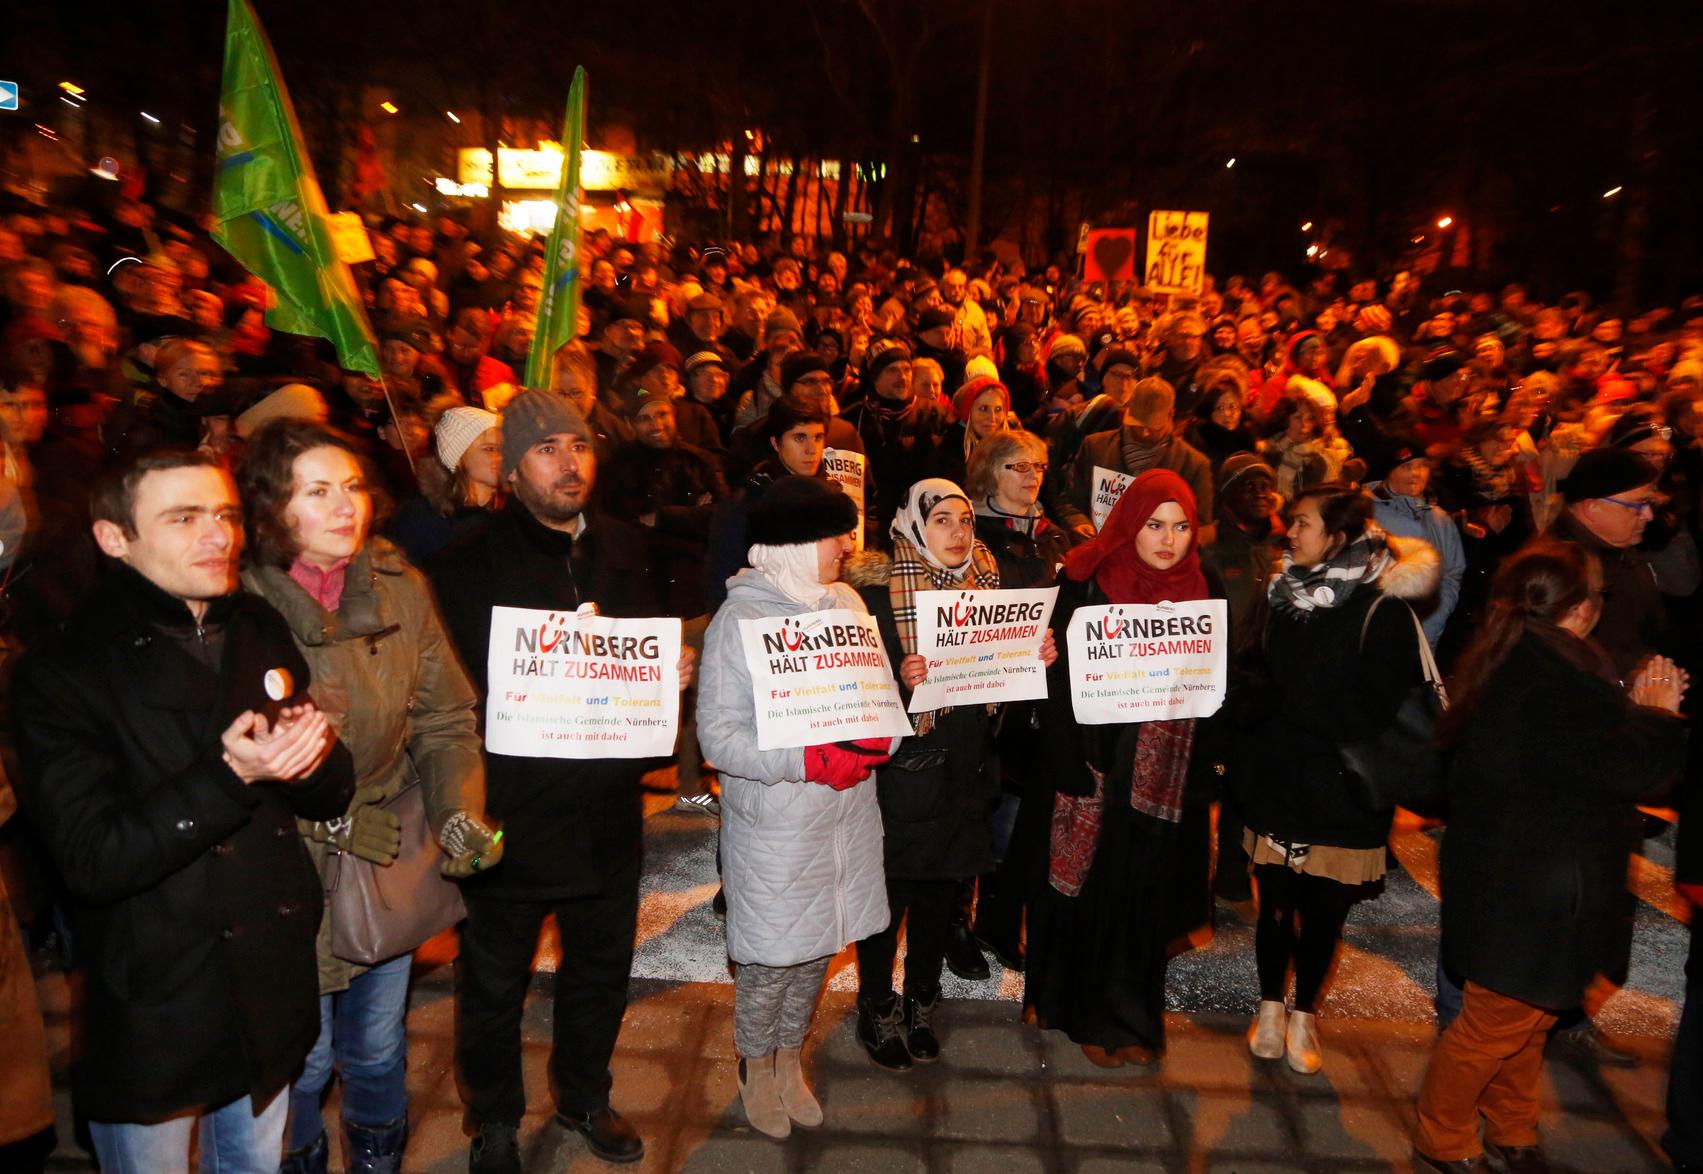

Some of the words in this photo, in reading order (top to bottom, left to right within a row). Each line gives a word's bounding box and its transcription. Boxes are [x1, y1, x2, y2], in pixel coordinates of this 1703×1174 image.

[824, 458, 862, 476] NBERG
[937, 592, 1044, 627] NÜRNBERG
[1086, 606, 1212, 641] NÜRNBERG
[515, 613, 659, 659] NÜRNBERG
[763, 618, 878, 654] NÜRNBERG
[936, 629, 967, 647] HÄLT
[970, 625, 1038, 644] ZUSAMMEN
[929, 660, 943, 668] Für
[945, 656, 976, 666] Vielfalt
[978, 653, 994, 662] und
[997, 649, 1032, 661] Toleranz
[1088, 642, 1123, 660] HÄLT
[1129, 640, 1211, 657] ZUSAMMEN
[513, 656, 559, 676] HÄLT
[565, 661, 661, 681] ZUSAMMEN
[770, 655, 808, 674] HÄLT
[814, 652, 884, 670] ZUSAMMEN
[934, 673, 966, 684] Islamische
[969, 669, 1000, 678] Gemeinde
[1003, 665, 1037, 674] Nürnberg
[1086, 673, 1103, 681] Für
[1106, 671, 1146, 680] Vielfalt
[1149, 668, 1169, 677] und
[1173, 667, 1211, 676] Toleranz
[771, 689, 791, 699] Für
[794, 685, 836, 697] Vielfalt
[839, 682, 857, 691] und
[861, 681, 891, 690] Toleranz
[946, 685, 954, 693] ist
[955, 683, 972, 692] auch
[974, 681, 985, 690] mit
[987, 680, 1005, 688] dabei
[1081, 691, 1093, 699] Die
[1097, 688, 1140, 697] Islamische
[1142, 686, 1181, 694] Gemeinde
[1182, 684, 1216, 692] Nürnberg
[505, 692, 527, 701] Für
[587, 696, 608, 705] und
[613, 697, 661, 707] Toleranz
[768, 710, 783, 719] Die
[786, 704, 831, 716] Islamische
[834, 701, 871, 712] Gemeinde
[871, 699, 899, 709] Nürnberg
[1130, 700, 1150, 708] auch
[497, 712, 513, 720] Die
[516, 713, 572, 725] Islamische
[575, 716, 622, 725] Gemeinde
[626, 717, 667, 727] Nürnberg
[810, 720, 820, 729] ist
[823, 717, 843, 727] auch
[845, 716, 859, 724] mit
[861, 714, 879, 722] dabei
[542, 731, 553, 739] ist
[557, 732, 582, 740] auch
[585, 732, 599, 740] mit
[601, 732, 627, 741] dabei
